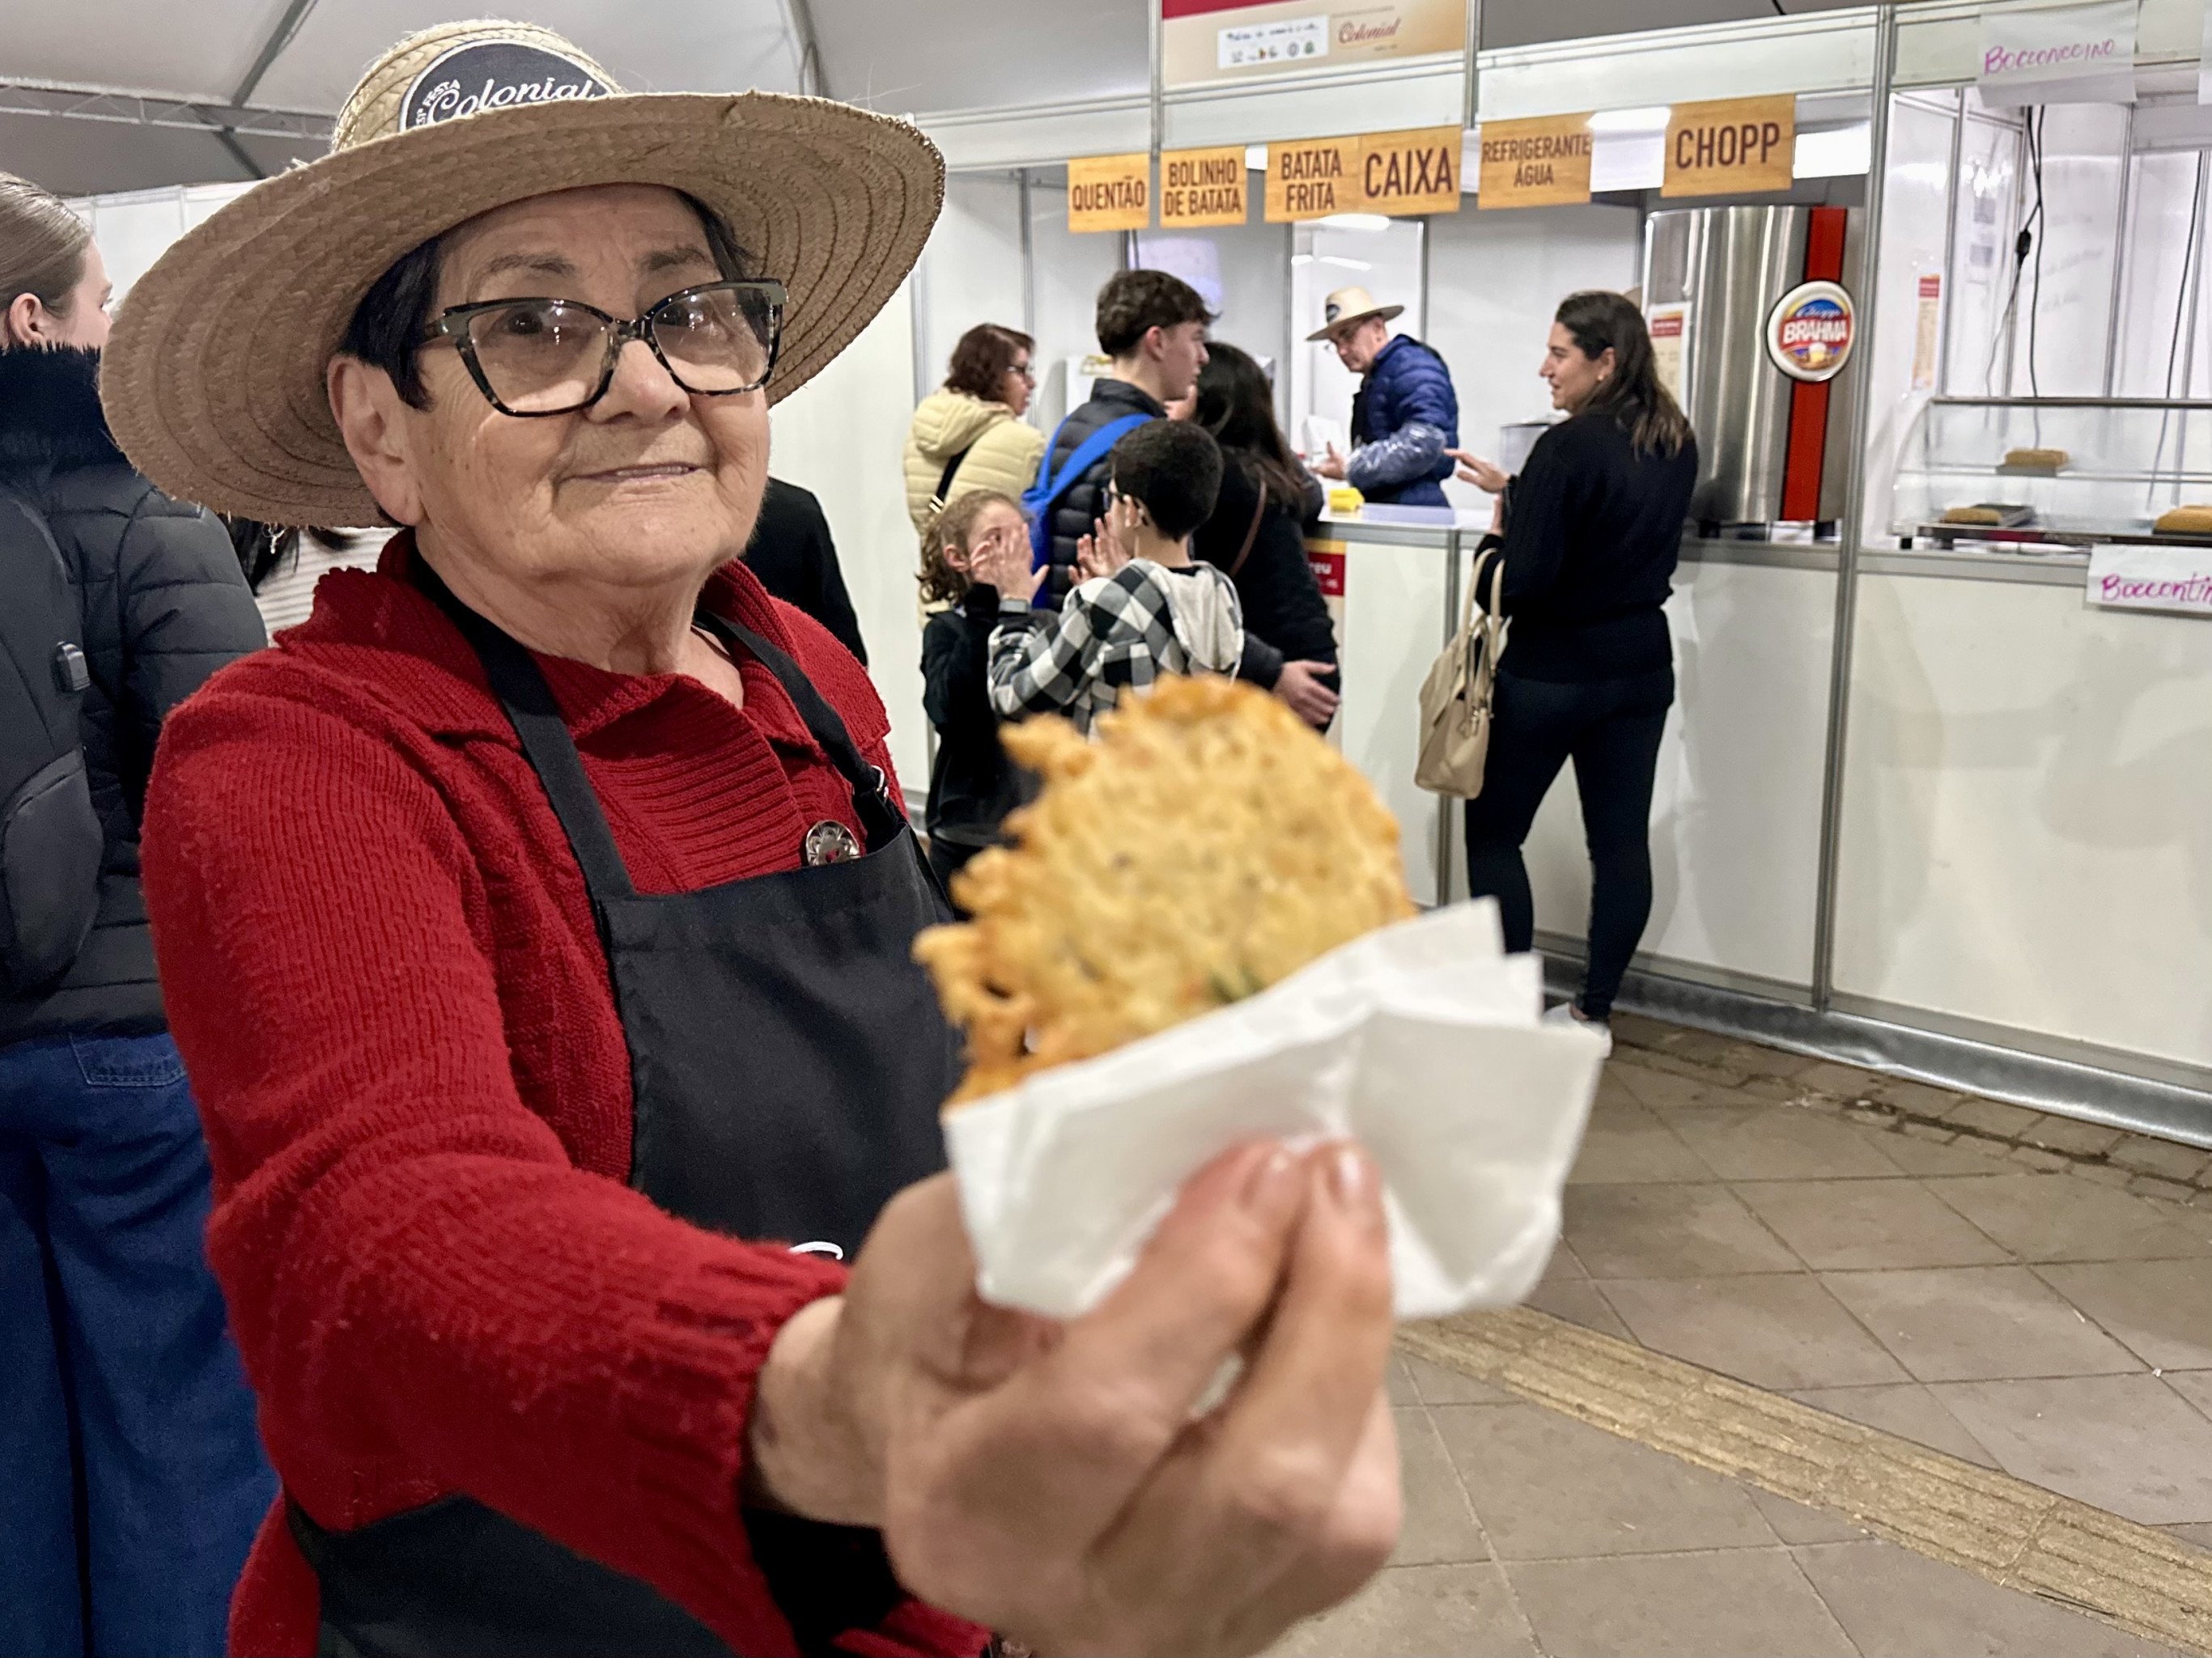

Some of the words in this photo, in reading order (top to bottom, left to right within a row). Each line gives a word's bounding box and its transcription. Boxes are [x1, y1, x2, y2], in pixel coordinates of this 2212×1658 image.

[422, 79, 461, 107] FESTA
[427, 77, 595, 125] Colonial
[1482, 133, 1591, 162] REFRIGERANTE
[1675, 122, 1781, 169] CHOPP
[1168, 159, 1238, 188] BOLINHO
[1281, 149, 1343, 180] BATATA
[1365, 147, 1453, 198] CAIXA
[1514, 160, 1554, 187] ÁGUA
[1072, 176, 1146, 211] QUENTÃO
[1165, 190, 1185, 216] DE
[1189, 188, 1242, 215] BATATA
[1286, 182, 1335, 212] FRITA
[1783, 320, 1847, 344] BRAHMA
